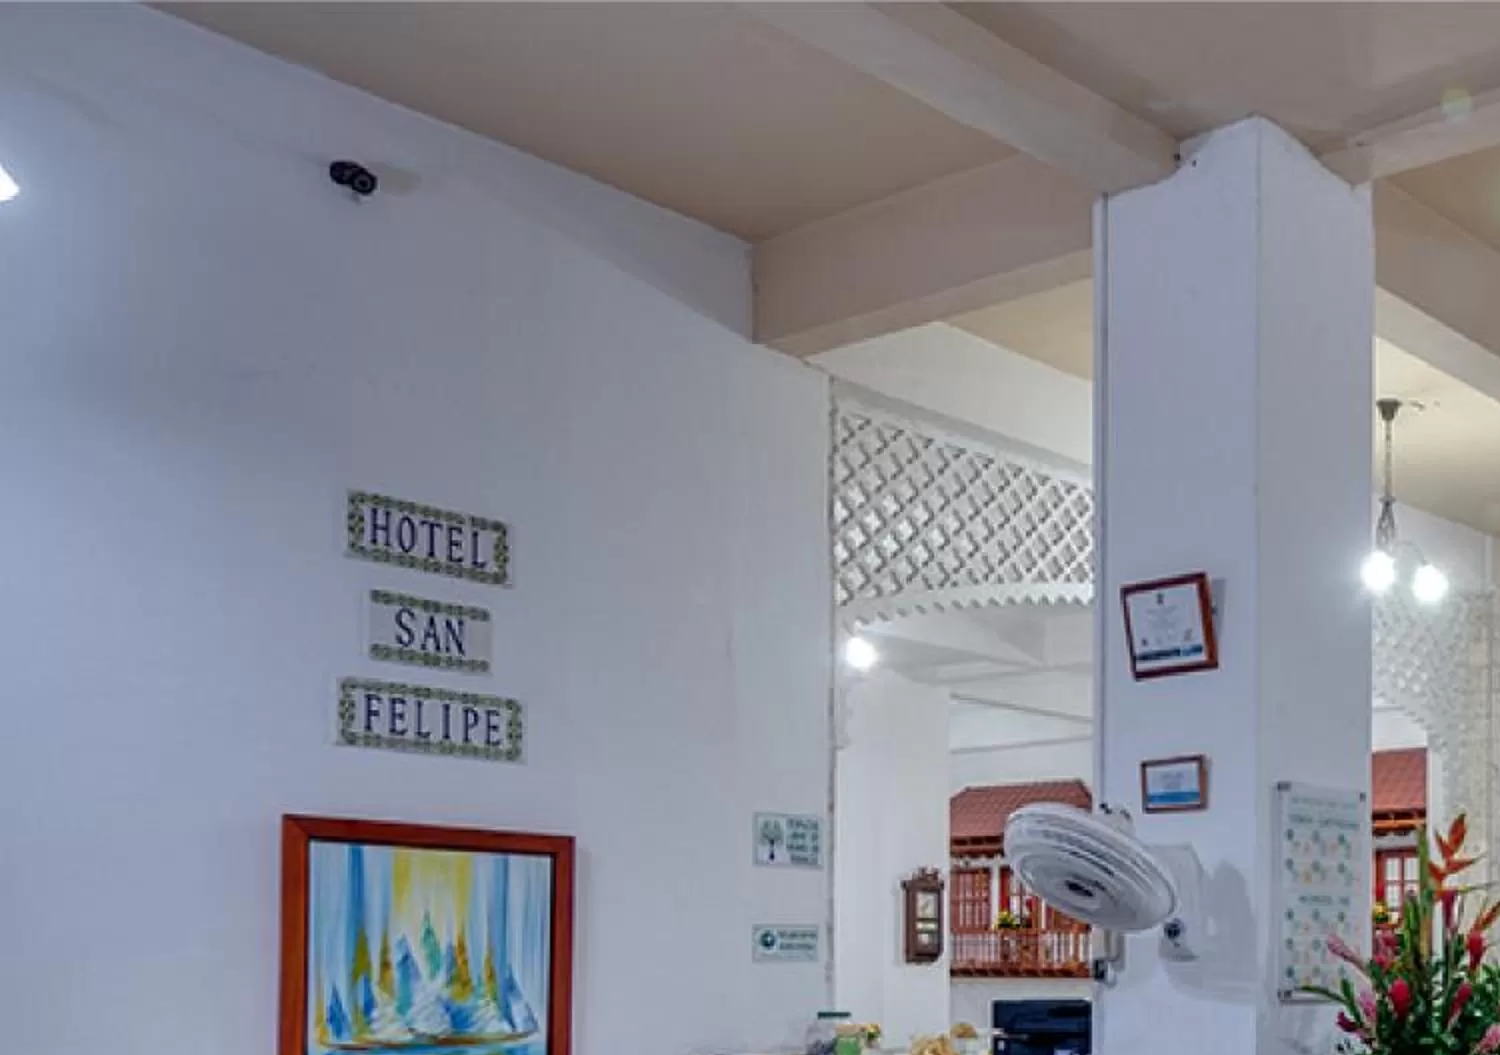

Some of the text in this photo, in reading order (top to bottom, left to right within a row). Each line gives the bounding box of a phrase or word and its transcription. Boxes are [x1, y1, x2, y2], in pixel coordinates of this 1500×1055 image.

[370, 507, 488, 569] HOTEL
[394, 607, 466, 656] SAN
[363, 693, 503, 747] FELIPE
